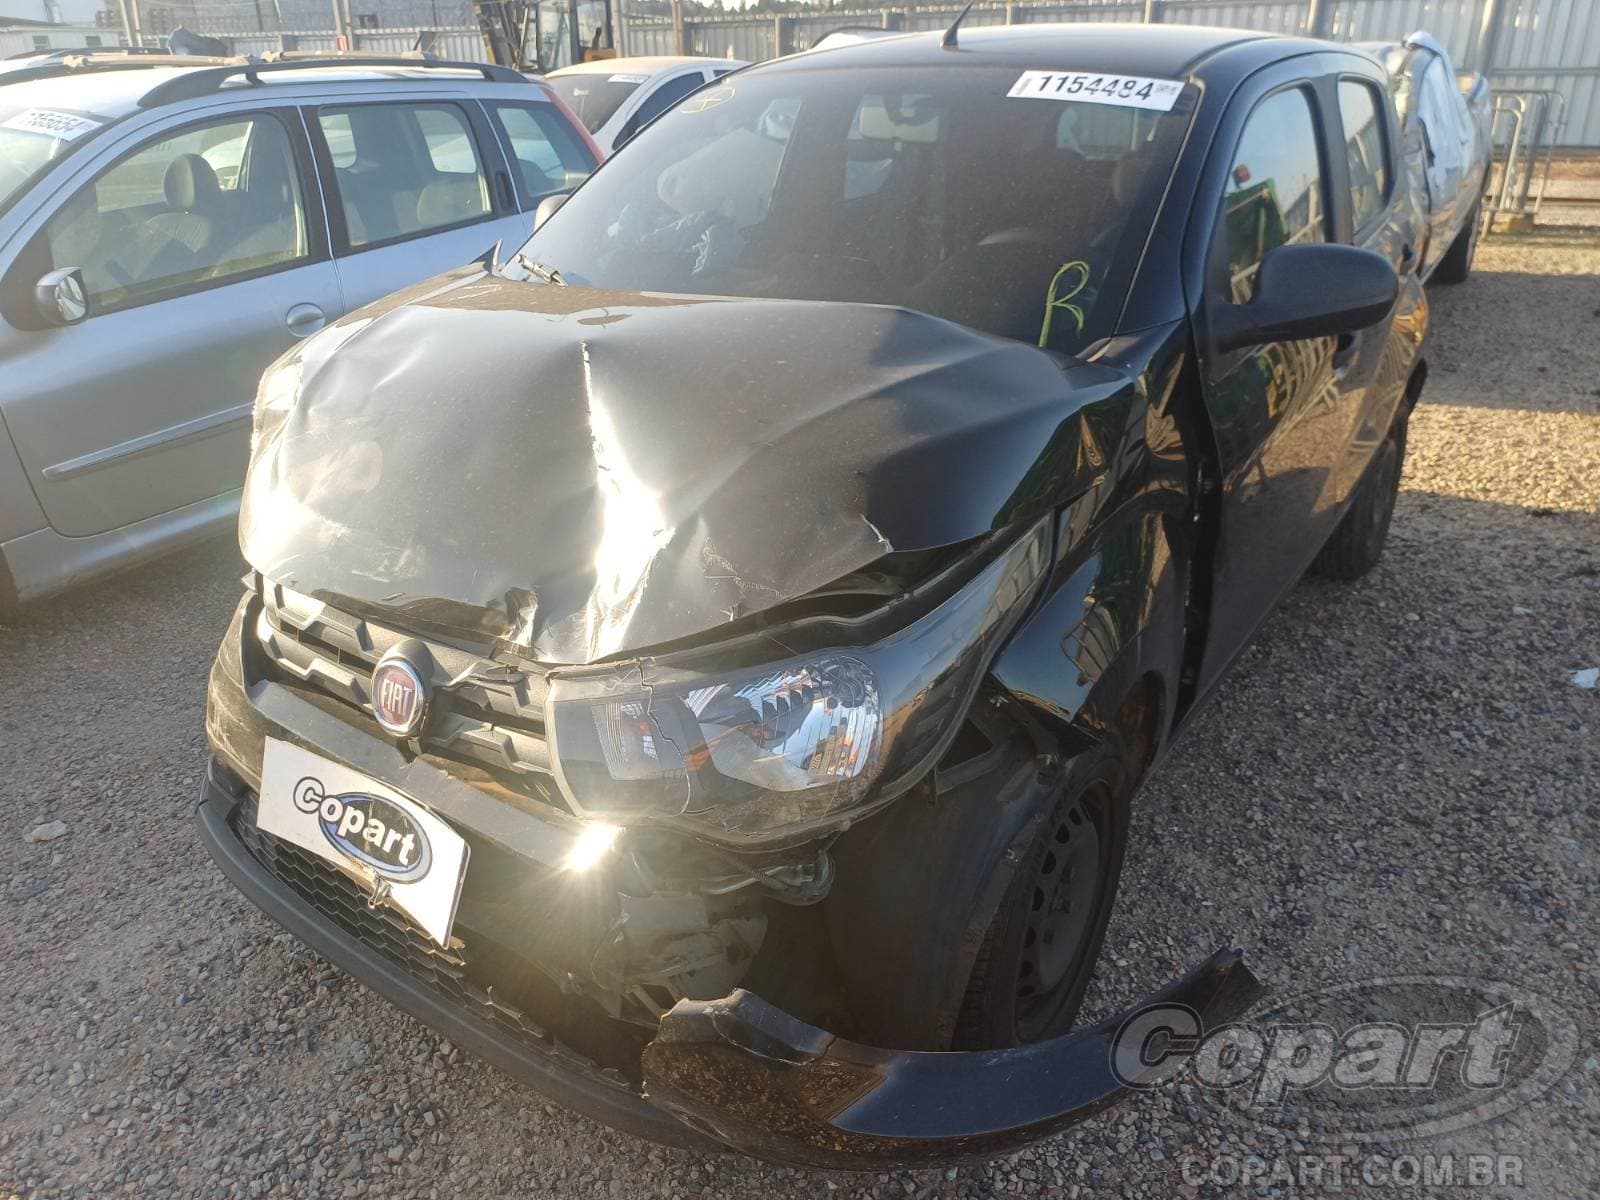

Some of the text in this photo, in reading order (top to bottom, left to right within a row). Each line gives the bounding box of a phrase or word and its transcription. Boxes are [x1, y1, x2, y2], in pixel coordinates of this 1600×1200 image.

[1038, 75, 1155, 101] 1154484
[1038, 261, 1090, 348] R
[381, 678, 413, 719] FIAT
[293, 776, 416, 866] Copart
